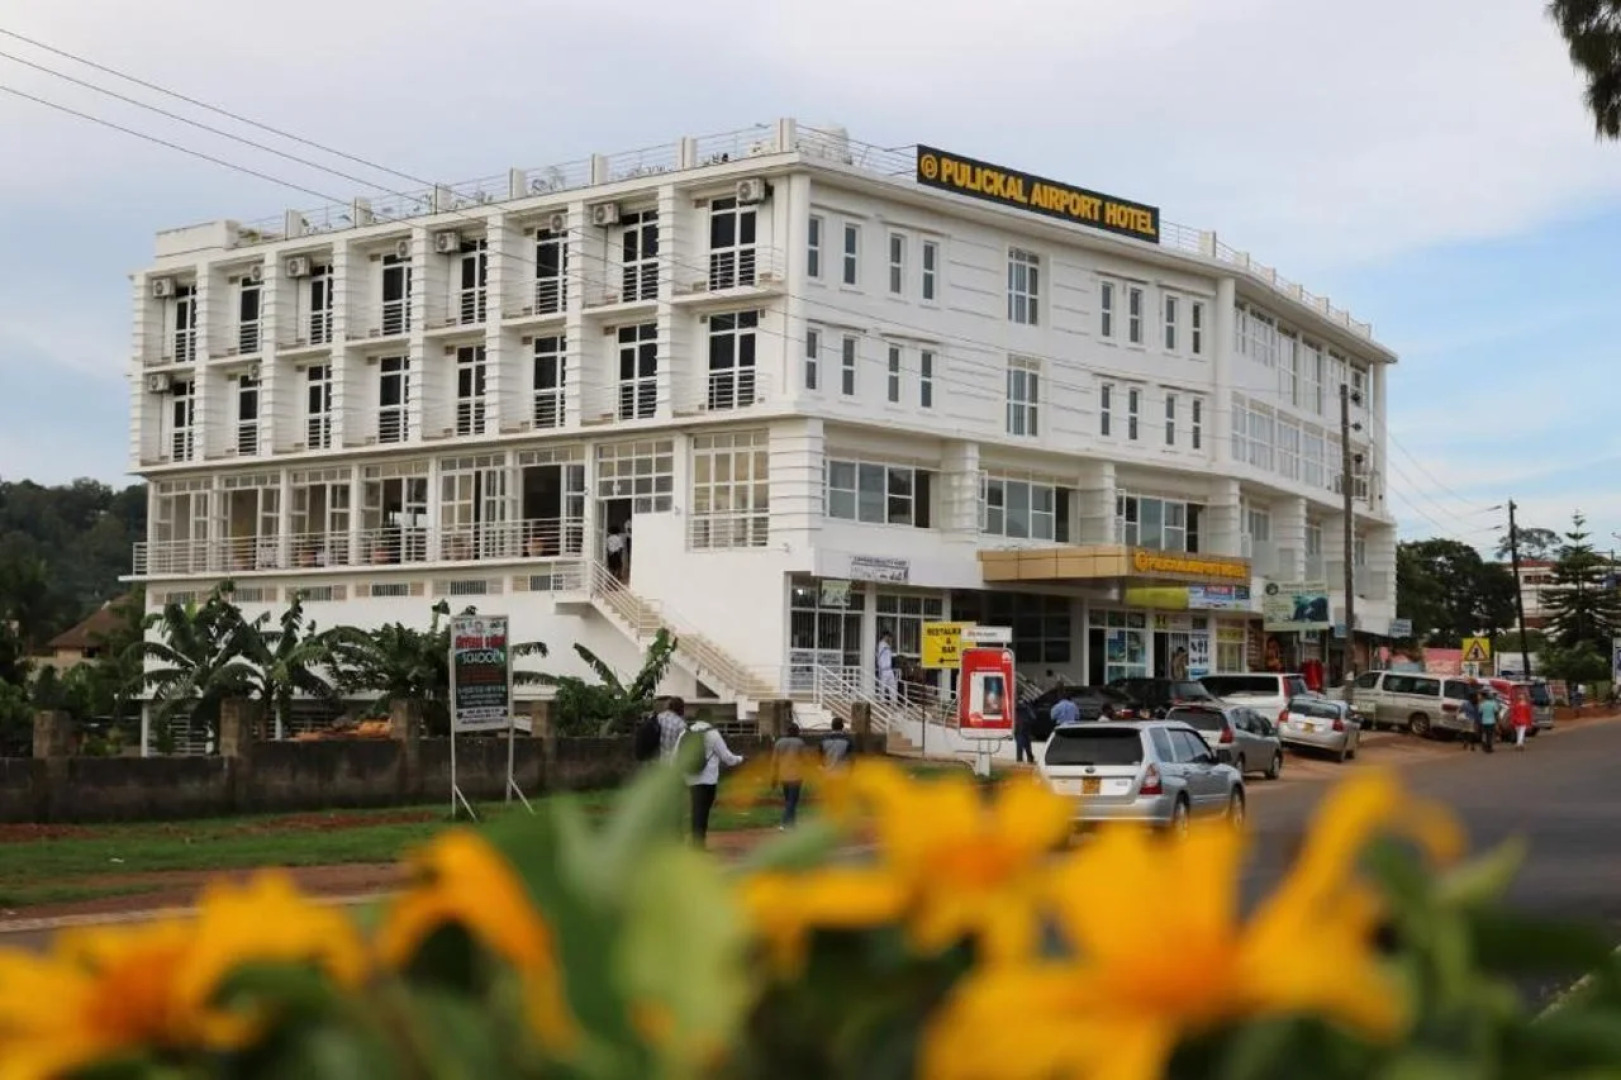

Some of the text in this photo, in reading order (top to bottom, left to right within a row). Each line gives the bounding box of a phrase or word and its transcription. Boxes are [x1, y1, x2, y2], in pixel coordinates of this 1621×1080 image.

[941, 157, 1156, 235] PULICKAL AIRPORT HOTEL
